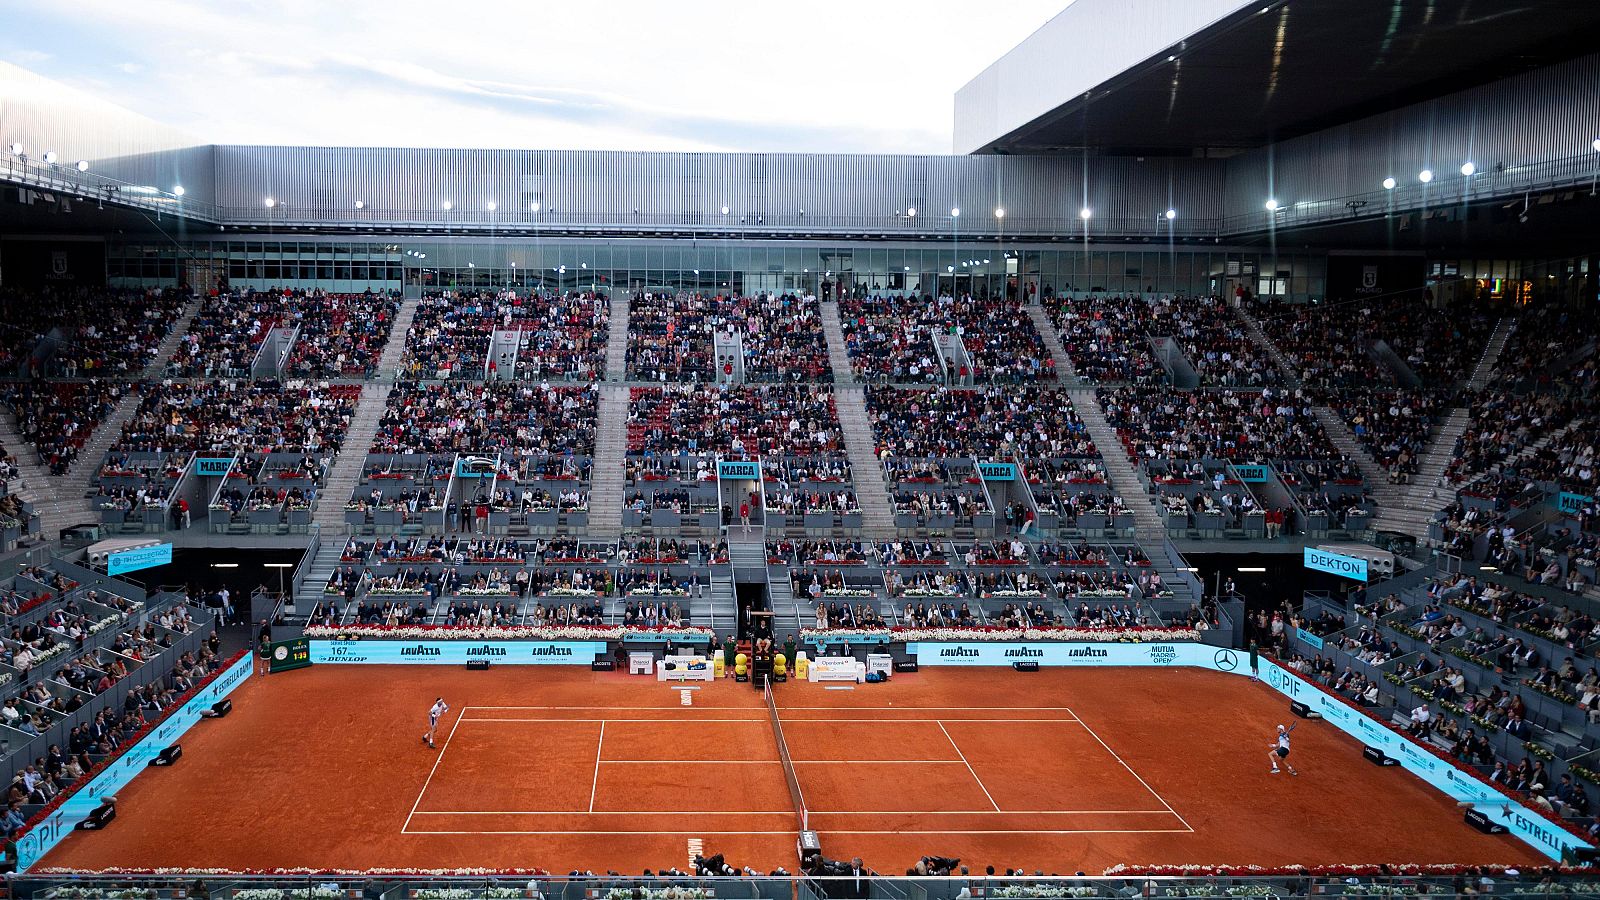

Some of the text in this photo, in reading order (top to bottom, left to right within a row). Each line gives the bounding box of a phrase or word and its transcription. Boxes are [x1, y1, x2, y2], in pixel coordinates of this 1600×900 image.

[200, 461, 231, 471] MARC
[721, 466, 755, 475] MARCA
[980, 467, 1012, 476] MARCA
[1311, 554, 1360, 574] DEKTON
[331, 647, 348, 655] 167
[401, 645, 440, 656] LAVAZZA
[466, 645, 507, 656] LAVAZZA
[532, 645, 573, 656] LAVAZZA
[940, 646, 980, 656] LAVAZZA
[1004, 646, 1044, 657] LAVAZZA
[1068, 646, 1108, 657] LAVAZZA
[219, 669, 240, 695] ESTRELLA
[1282, 673, 1301, 697] PIF
[1365, 747, 1379, 758] LACOSTE
[100, 806, 114, 820] LACOSTE
[1467, 811, 1486, 825] LACOSTE
[39, 811, 64, 851] PIF
[802, 831, 815, 848] Haier
